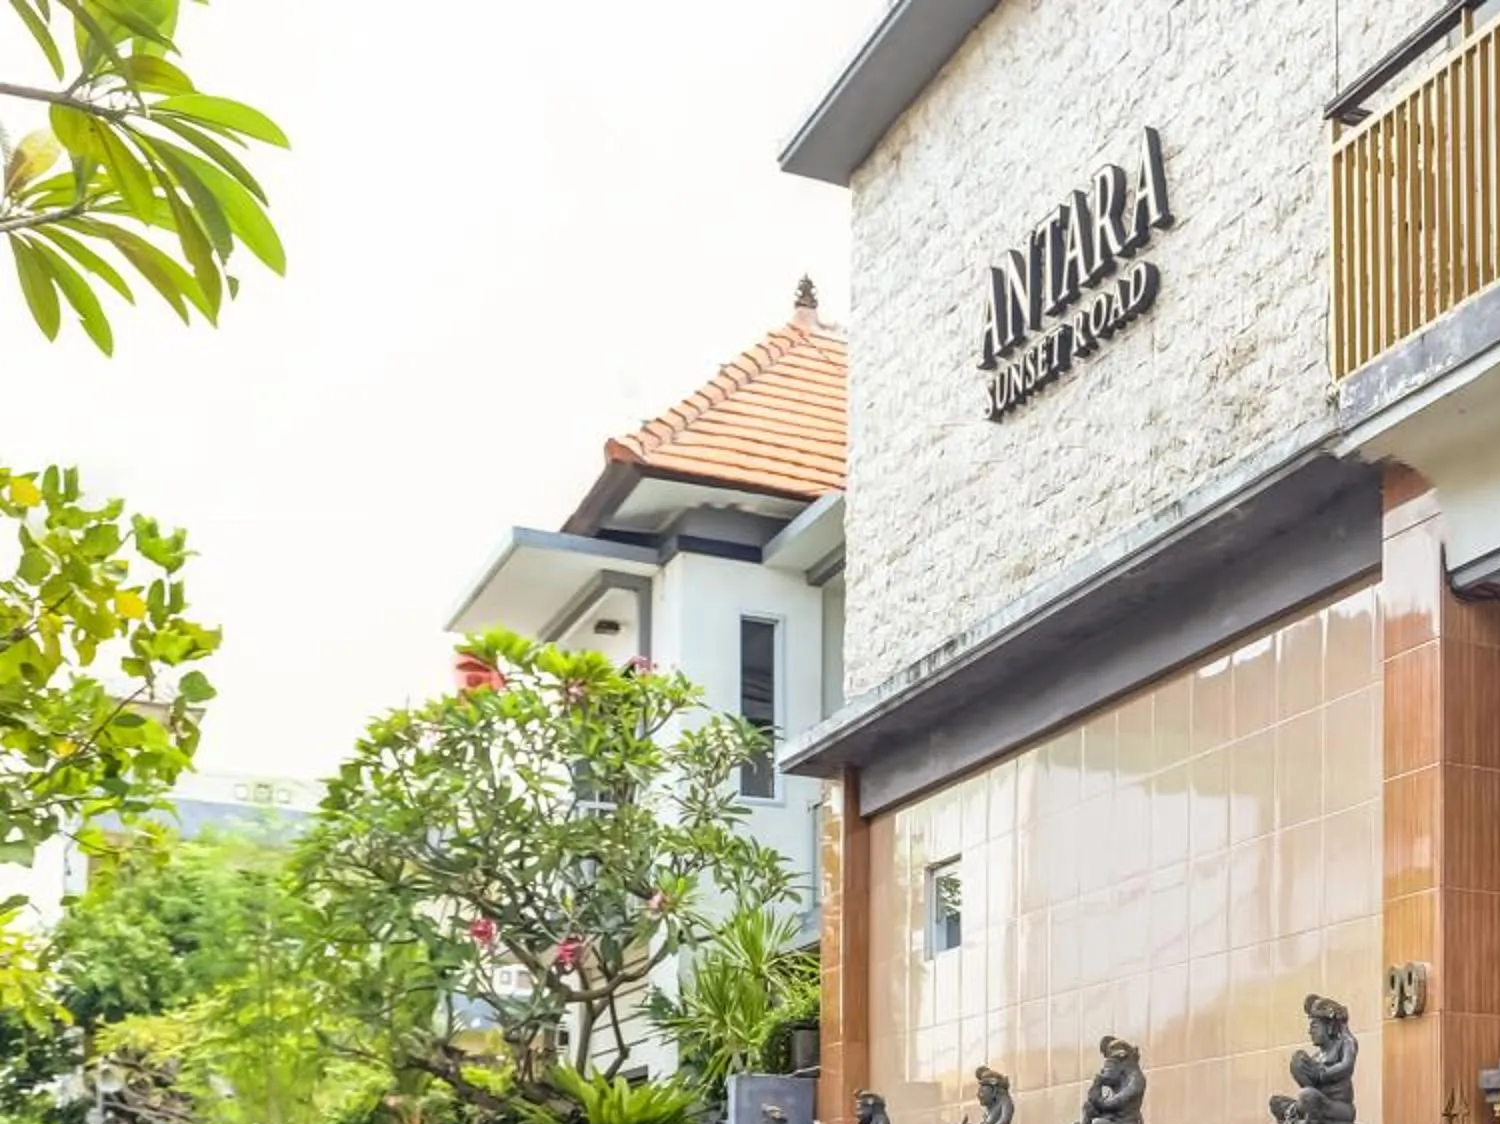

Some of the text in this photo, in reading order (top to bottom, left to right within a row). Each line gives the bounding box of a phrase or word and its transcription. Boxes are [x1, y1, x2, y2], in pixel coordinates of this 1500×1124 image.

[977, 125, 1174, 370] ANTARA
[985, 261, 1160, 424] SUNSET ROAD
